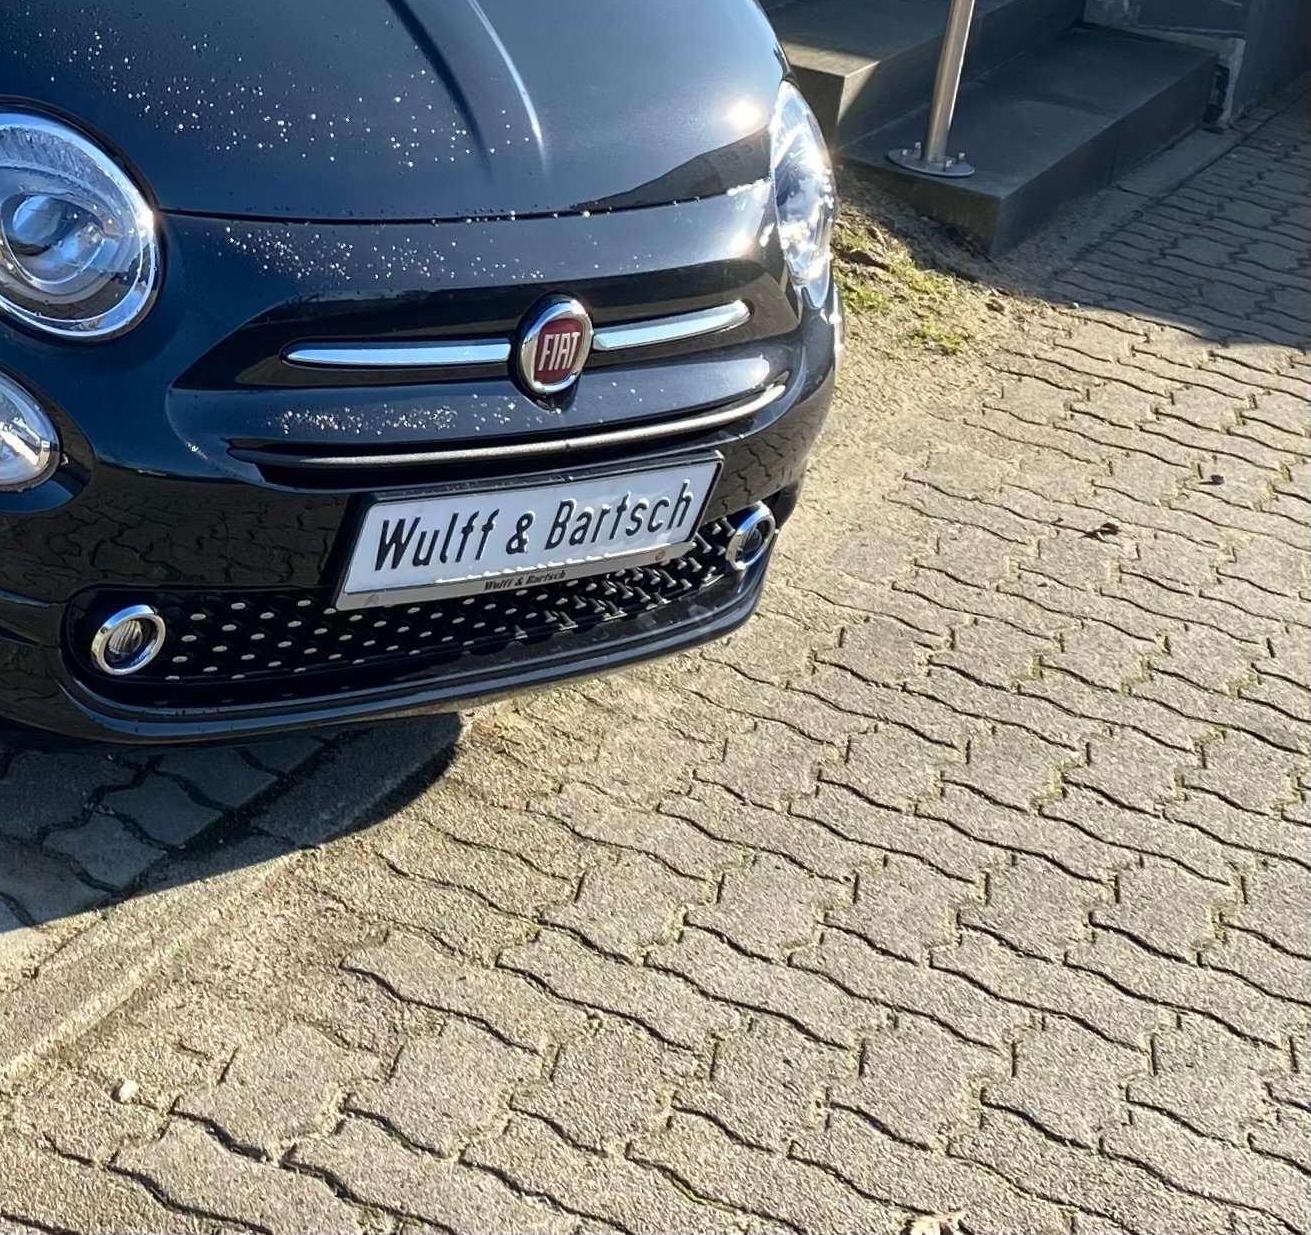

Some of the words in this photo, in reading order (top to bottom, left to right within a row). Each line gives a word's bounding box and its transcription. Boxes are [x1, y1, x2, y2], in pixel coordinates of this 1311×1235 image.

[537, 330, 581, 372] FIAT
[374, 507, 500, 573] Wulff
[504, 509, 536, 557] &
[545, 478, 694, 551] Bartsch
